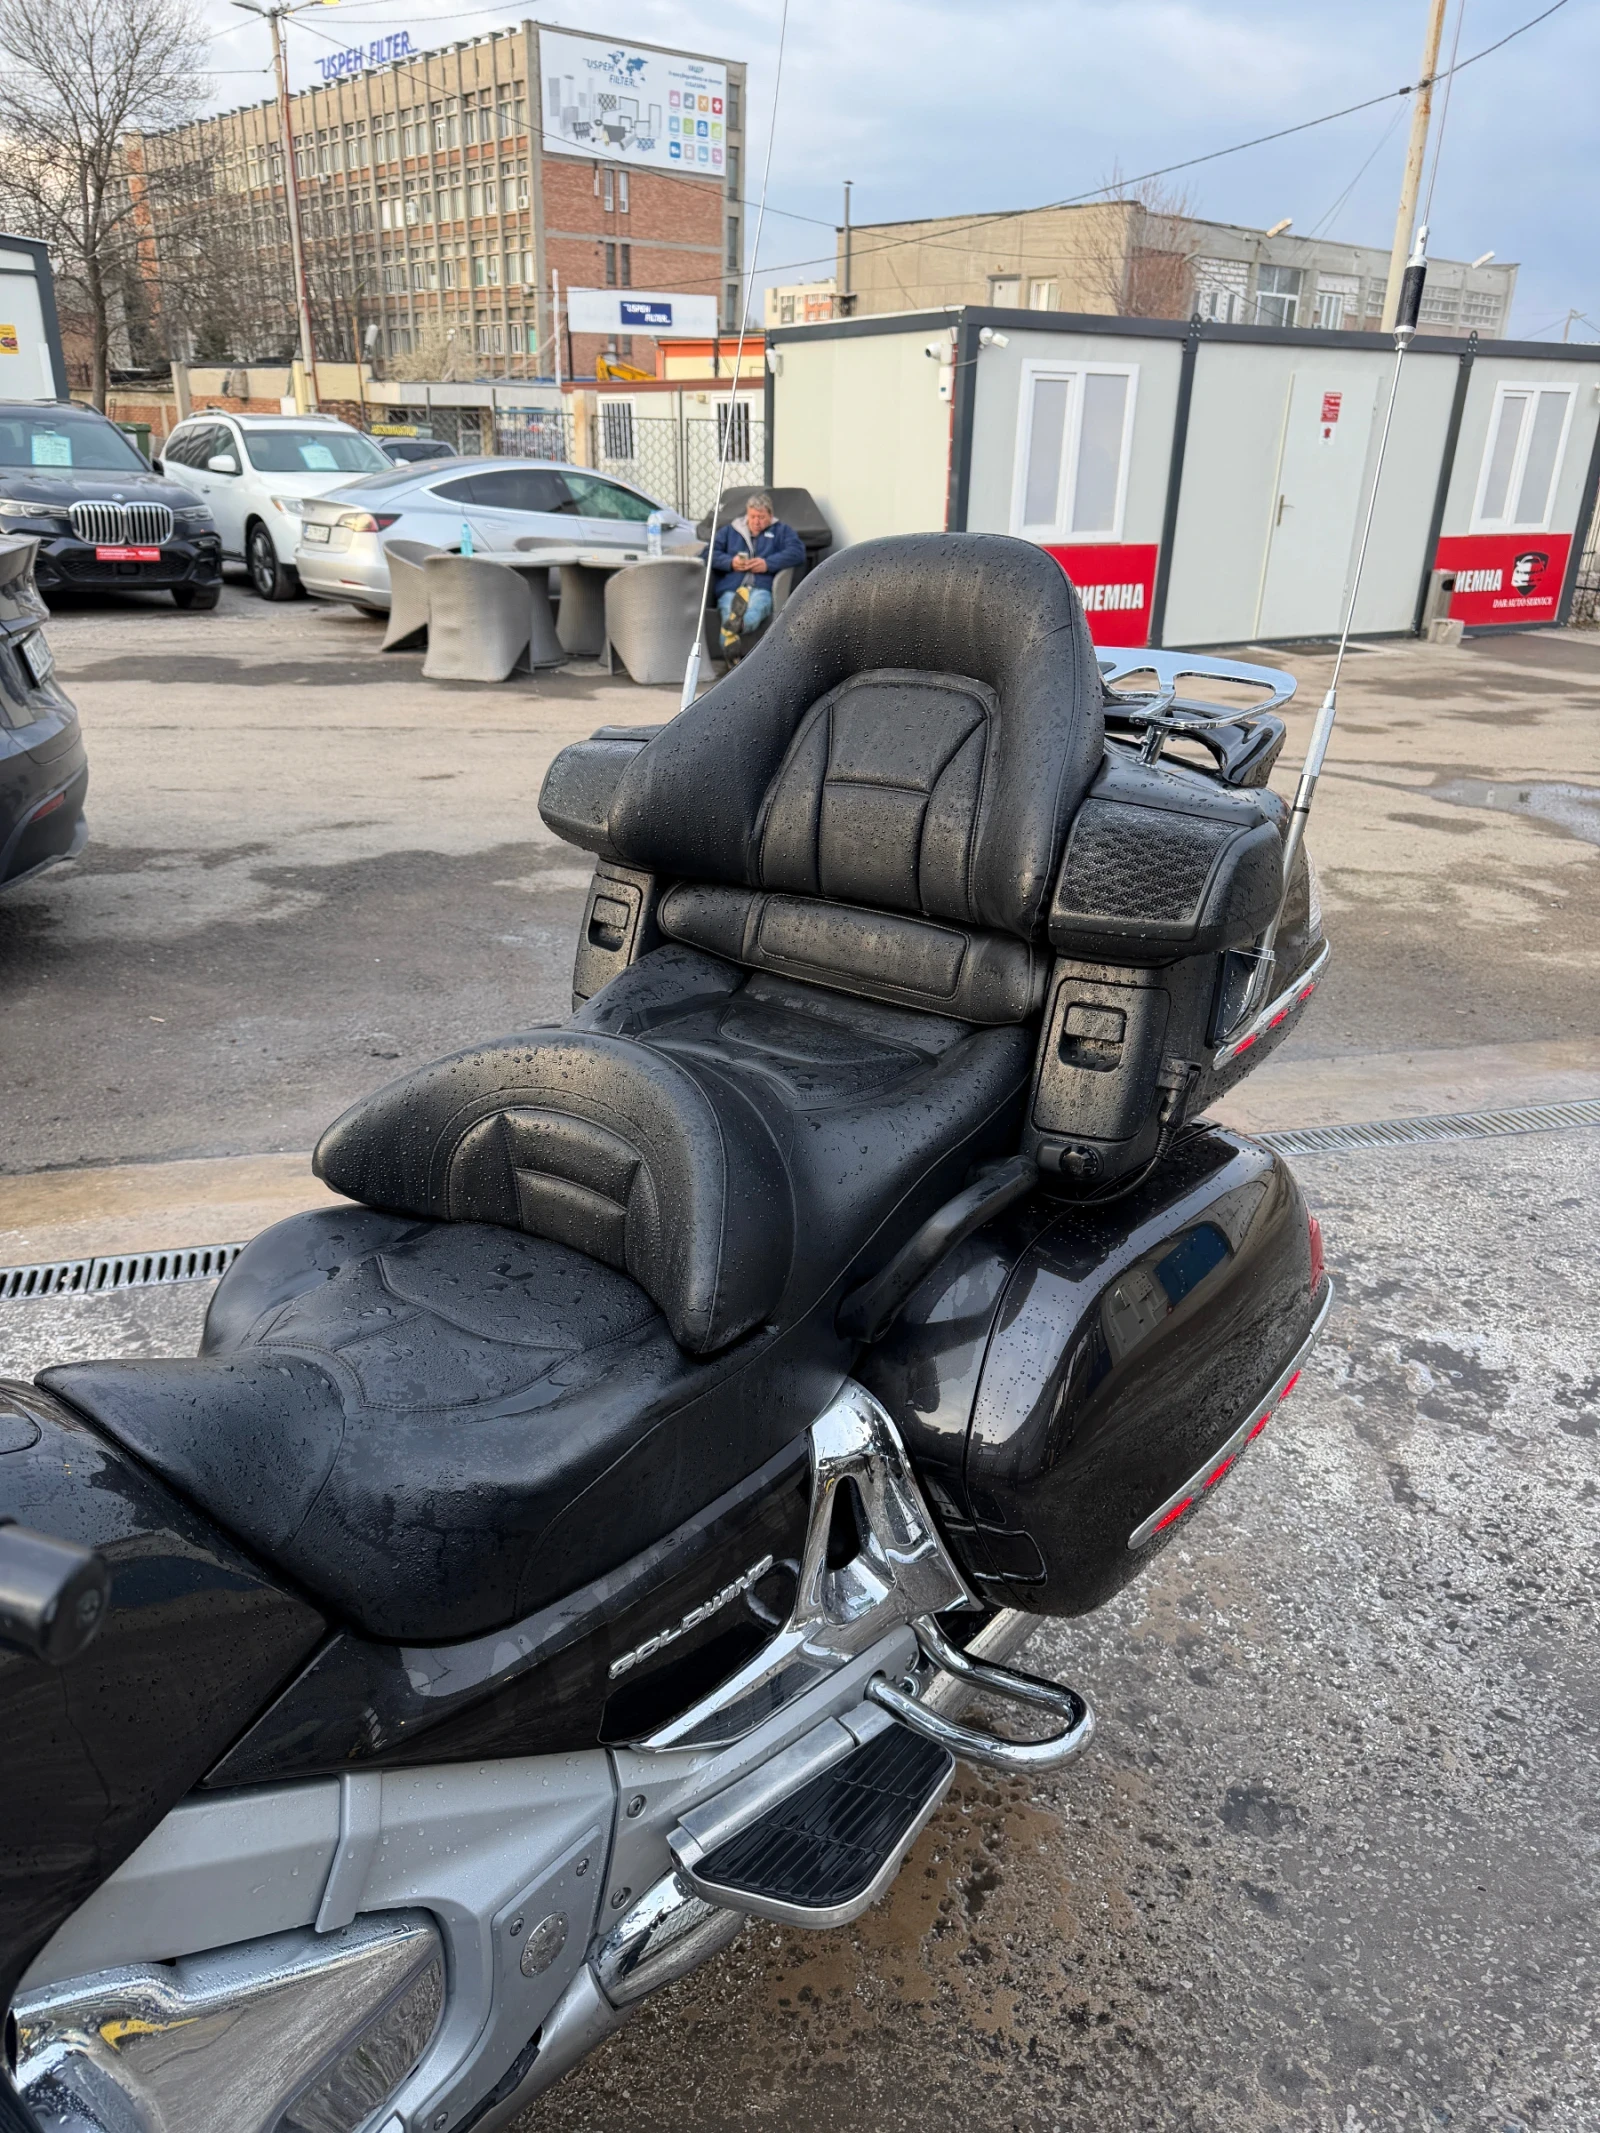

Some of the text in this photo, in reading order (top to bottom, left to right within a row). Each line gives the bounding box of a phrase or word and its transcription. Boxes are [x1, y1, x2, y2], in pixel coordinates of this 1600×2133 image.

[314, 31, 418, 80] USPEH FILTER
[582, 58, 615, 72] USPEH
[609, 74, 640, 88] FILTER
[1526, 596, 1553, 607] SERVICE
